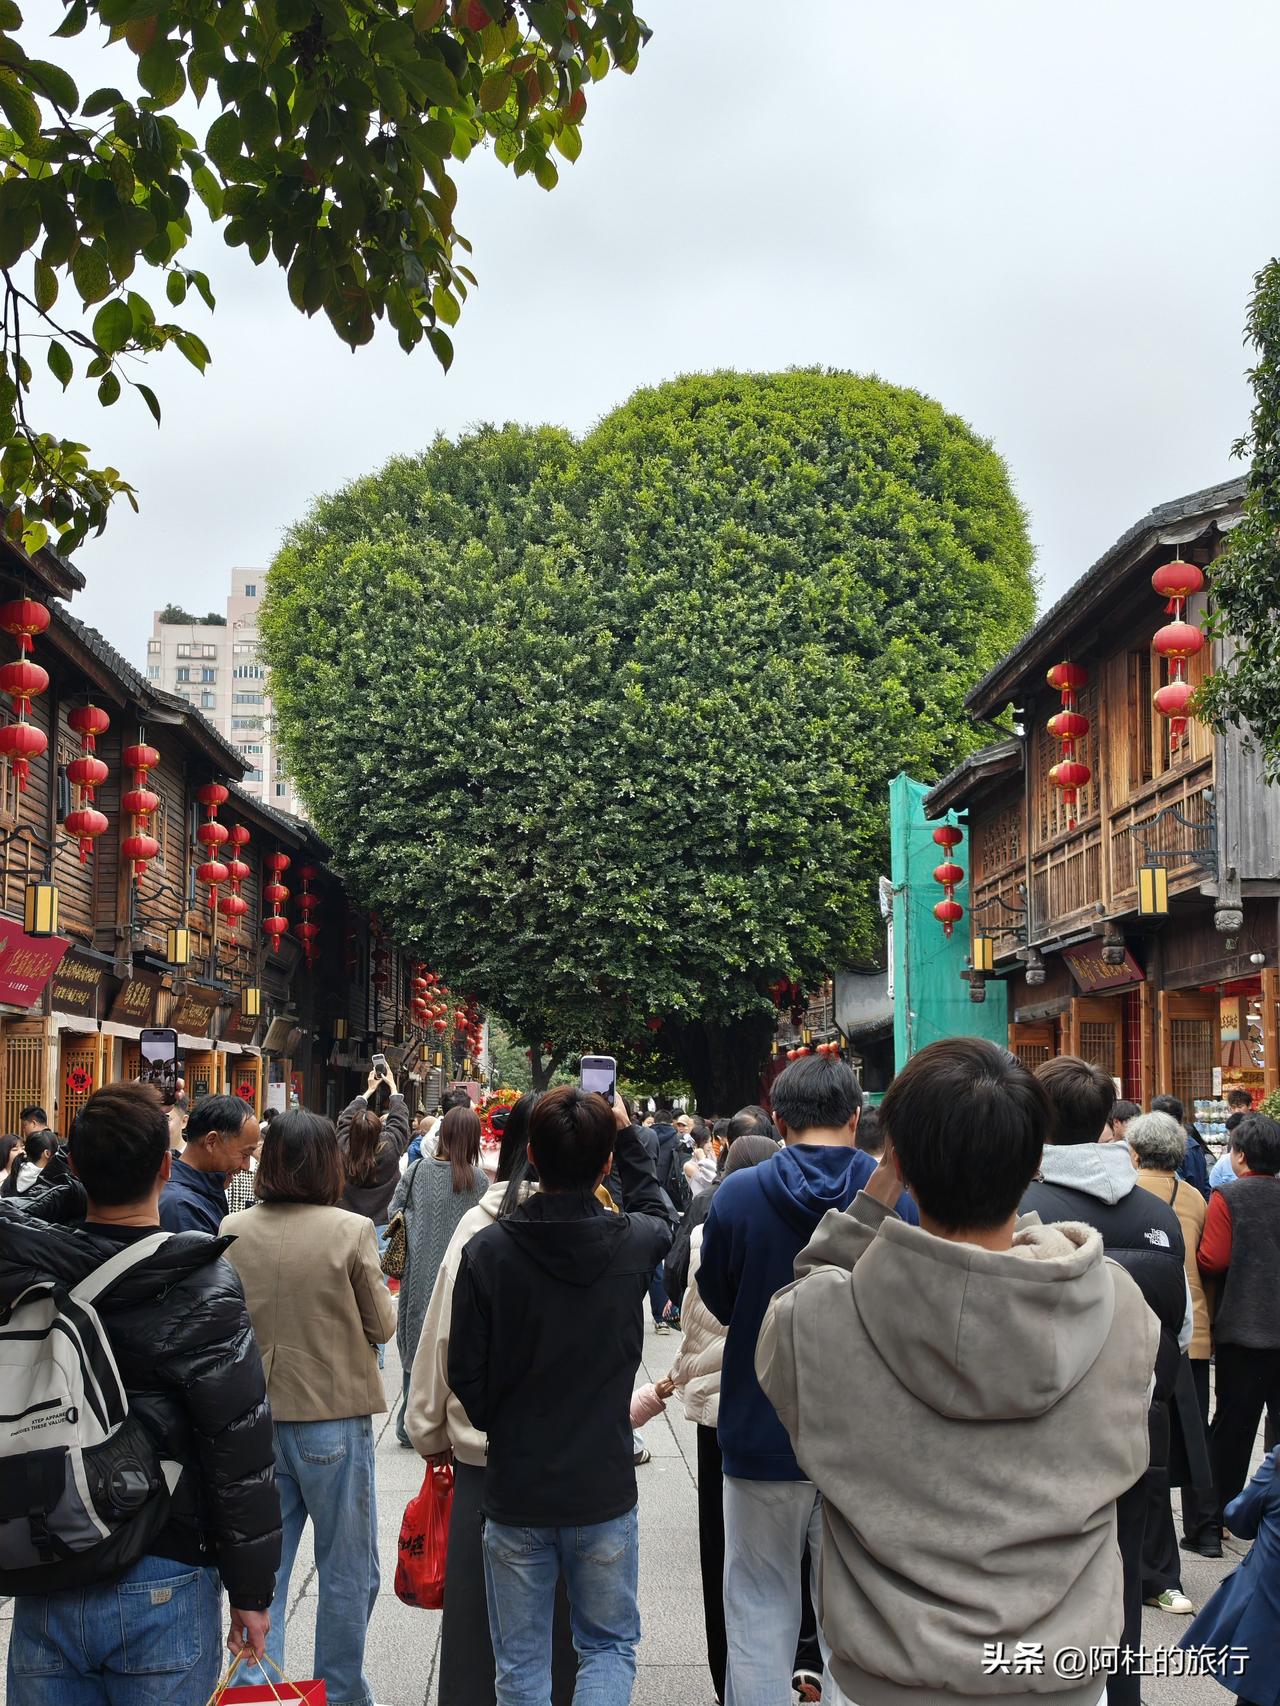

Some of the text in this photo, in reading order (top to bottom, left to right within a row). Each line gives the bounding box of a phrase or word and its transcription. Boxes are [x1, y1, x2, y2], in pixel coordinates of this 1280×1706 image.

[31, 1411, 67, 1425] XTEP APPARE
[31, 1422, 47, 1431] THESE
